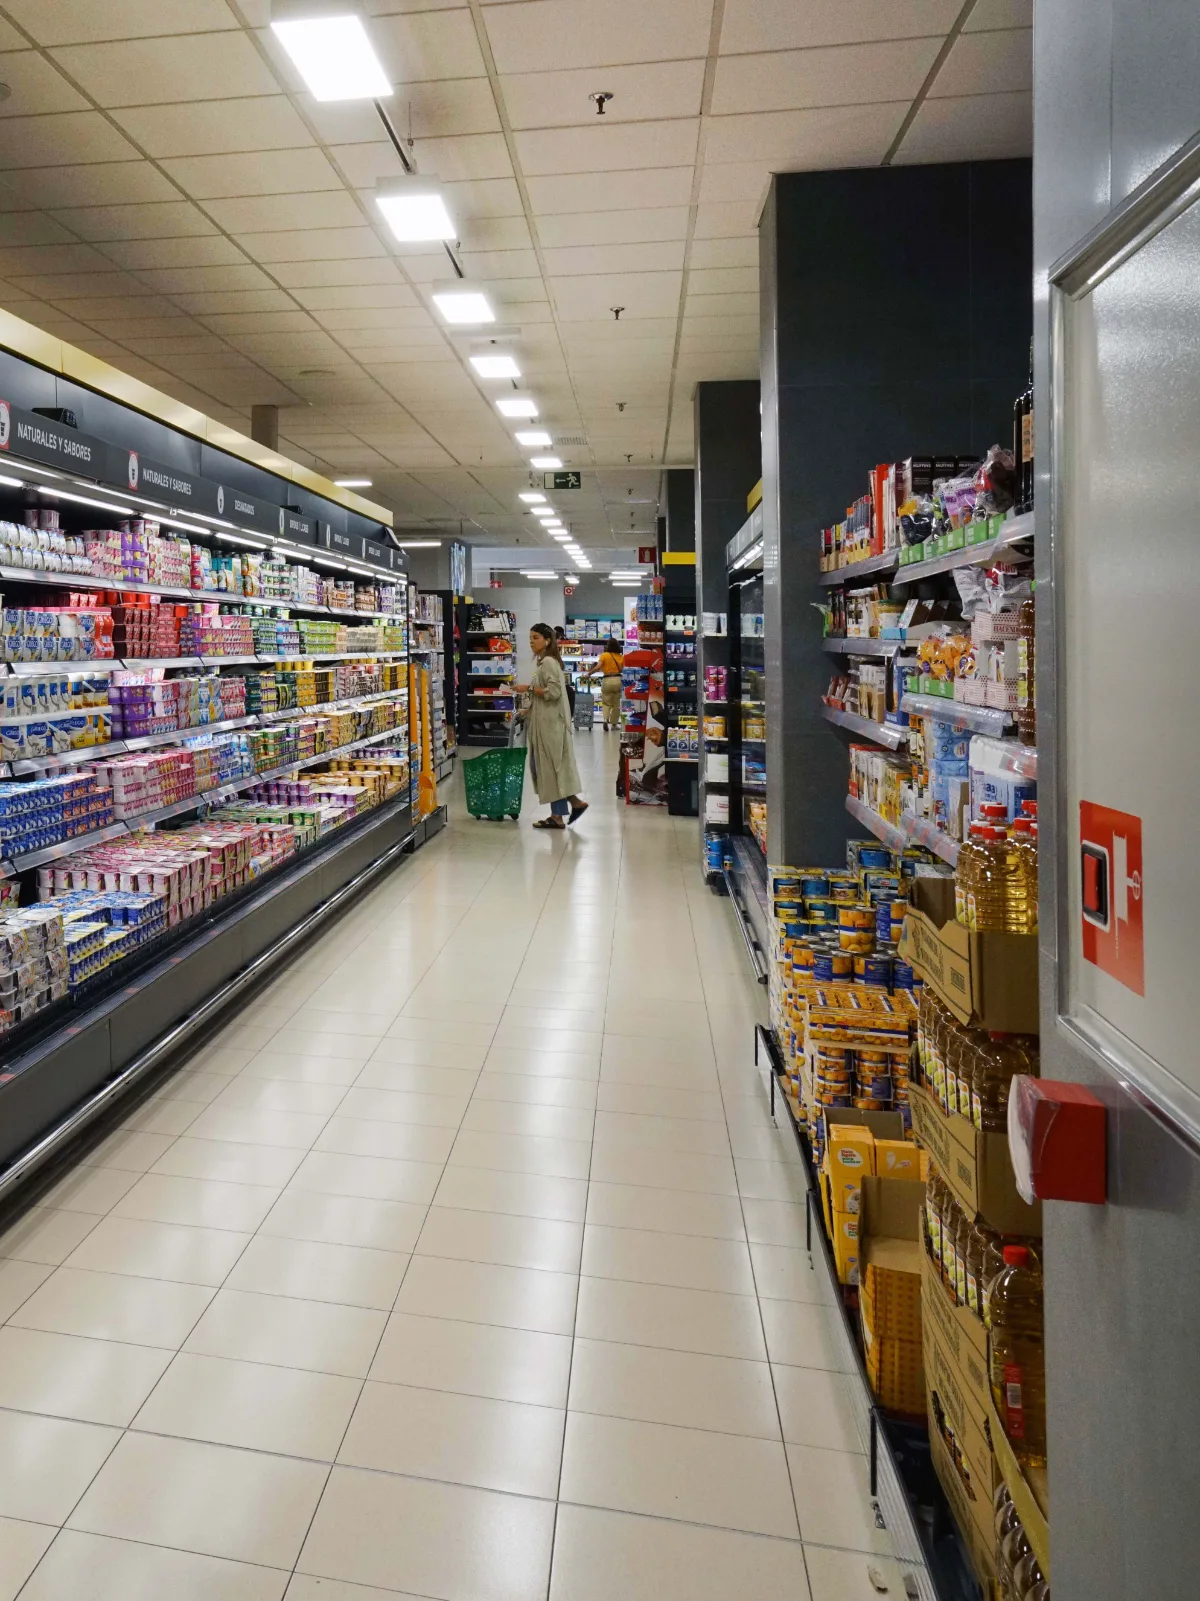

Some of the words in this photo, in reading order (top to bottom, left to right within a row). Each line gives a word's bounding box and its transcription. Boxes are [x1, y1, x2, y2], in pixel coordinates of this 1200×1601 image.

[17, 422, 57, 450] NATURALES
[58, 436, 64, 451] Y
[63, 438, 92, 462] SABORES
[142, 467, 169, 488] NATURALES
[172, 479, 192, 496] SABORES
